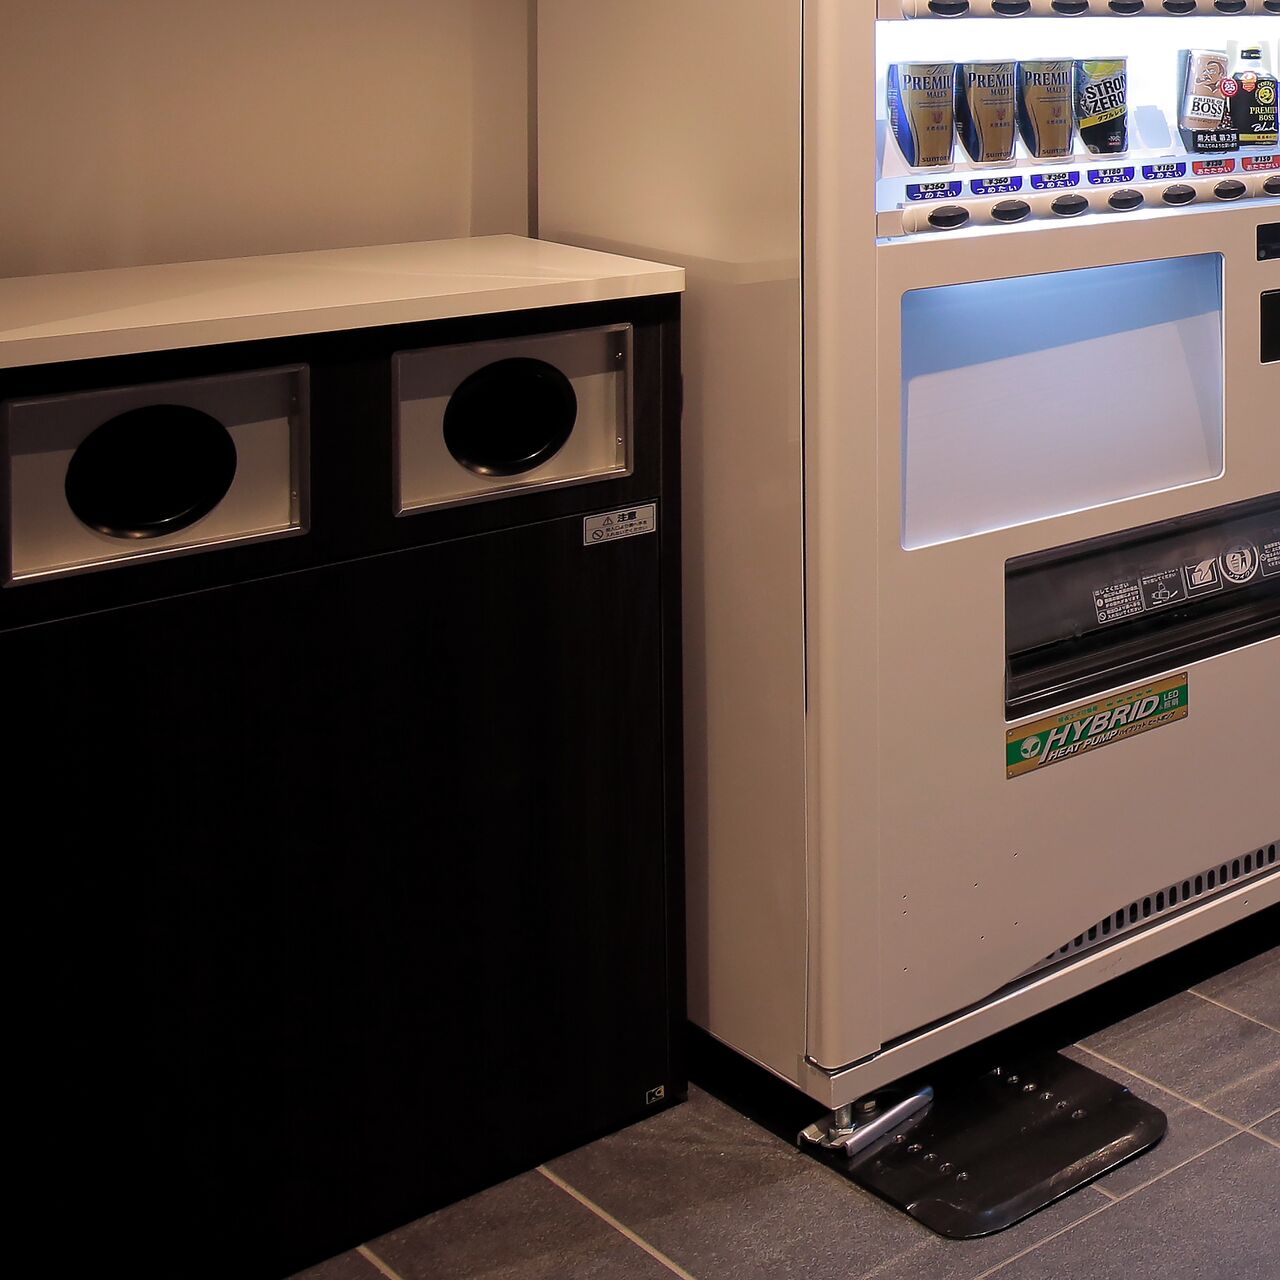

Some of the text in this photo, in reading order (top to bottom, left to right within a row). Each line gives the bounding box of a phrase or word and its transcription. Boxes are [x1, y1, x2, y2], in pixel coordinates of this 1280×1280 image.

[1225, 83, 1236, 91] 25
[1191, 102, 1224, 115] BOSS
[1258, 114, 1275, 122] BOSS
[1219, 132, 1238, 141] 第2弾
[1197, 166, 1232, 175] あたたかい
[1092, 175, 1131, 184] つめたい
[1146, 171, 1183, 180] つめたい
[923, 183, 946, 191] ¥360
[1036, 180, 1077, 189] つめたい
[976, 185, 1018, 194] つめたい
[913, 190, 957, 200] つめたい
[617, 511, 637, 523] 注意
[1163, 689, 1179, 701] LED
[1038, 694, 1160, 765] HYBRID
[1048, 729, 1120, 761] HEAT PUMP
